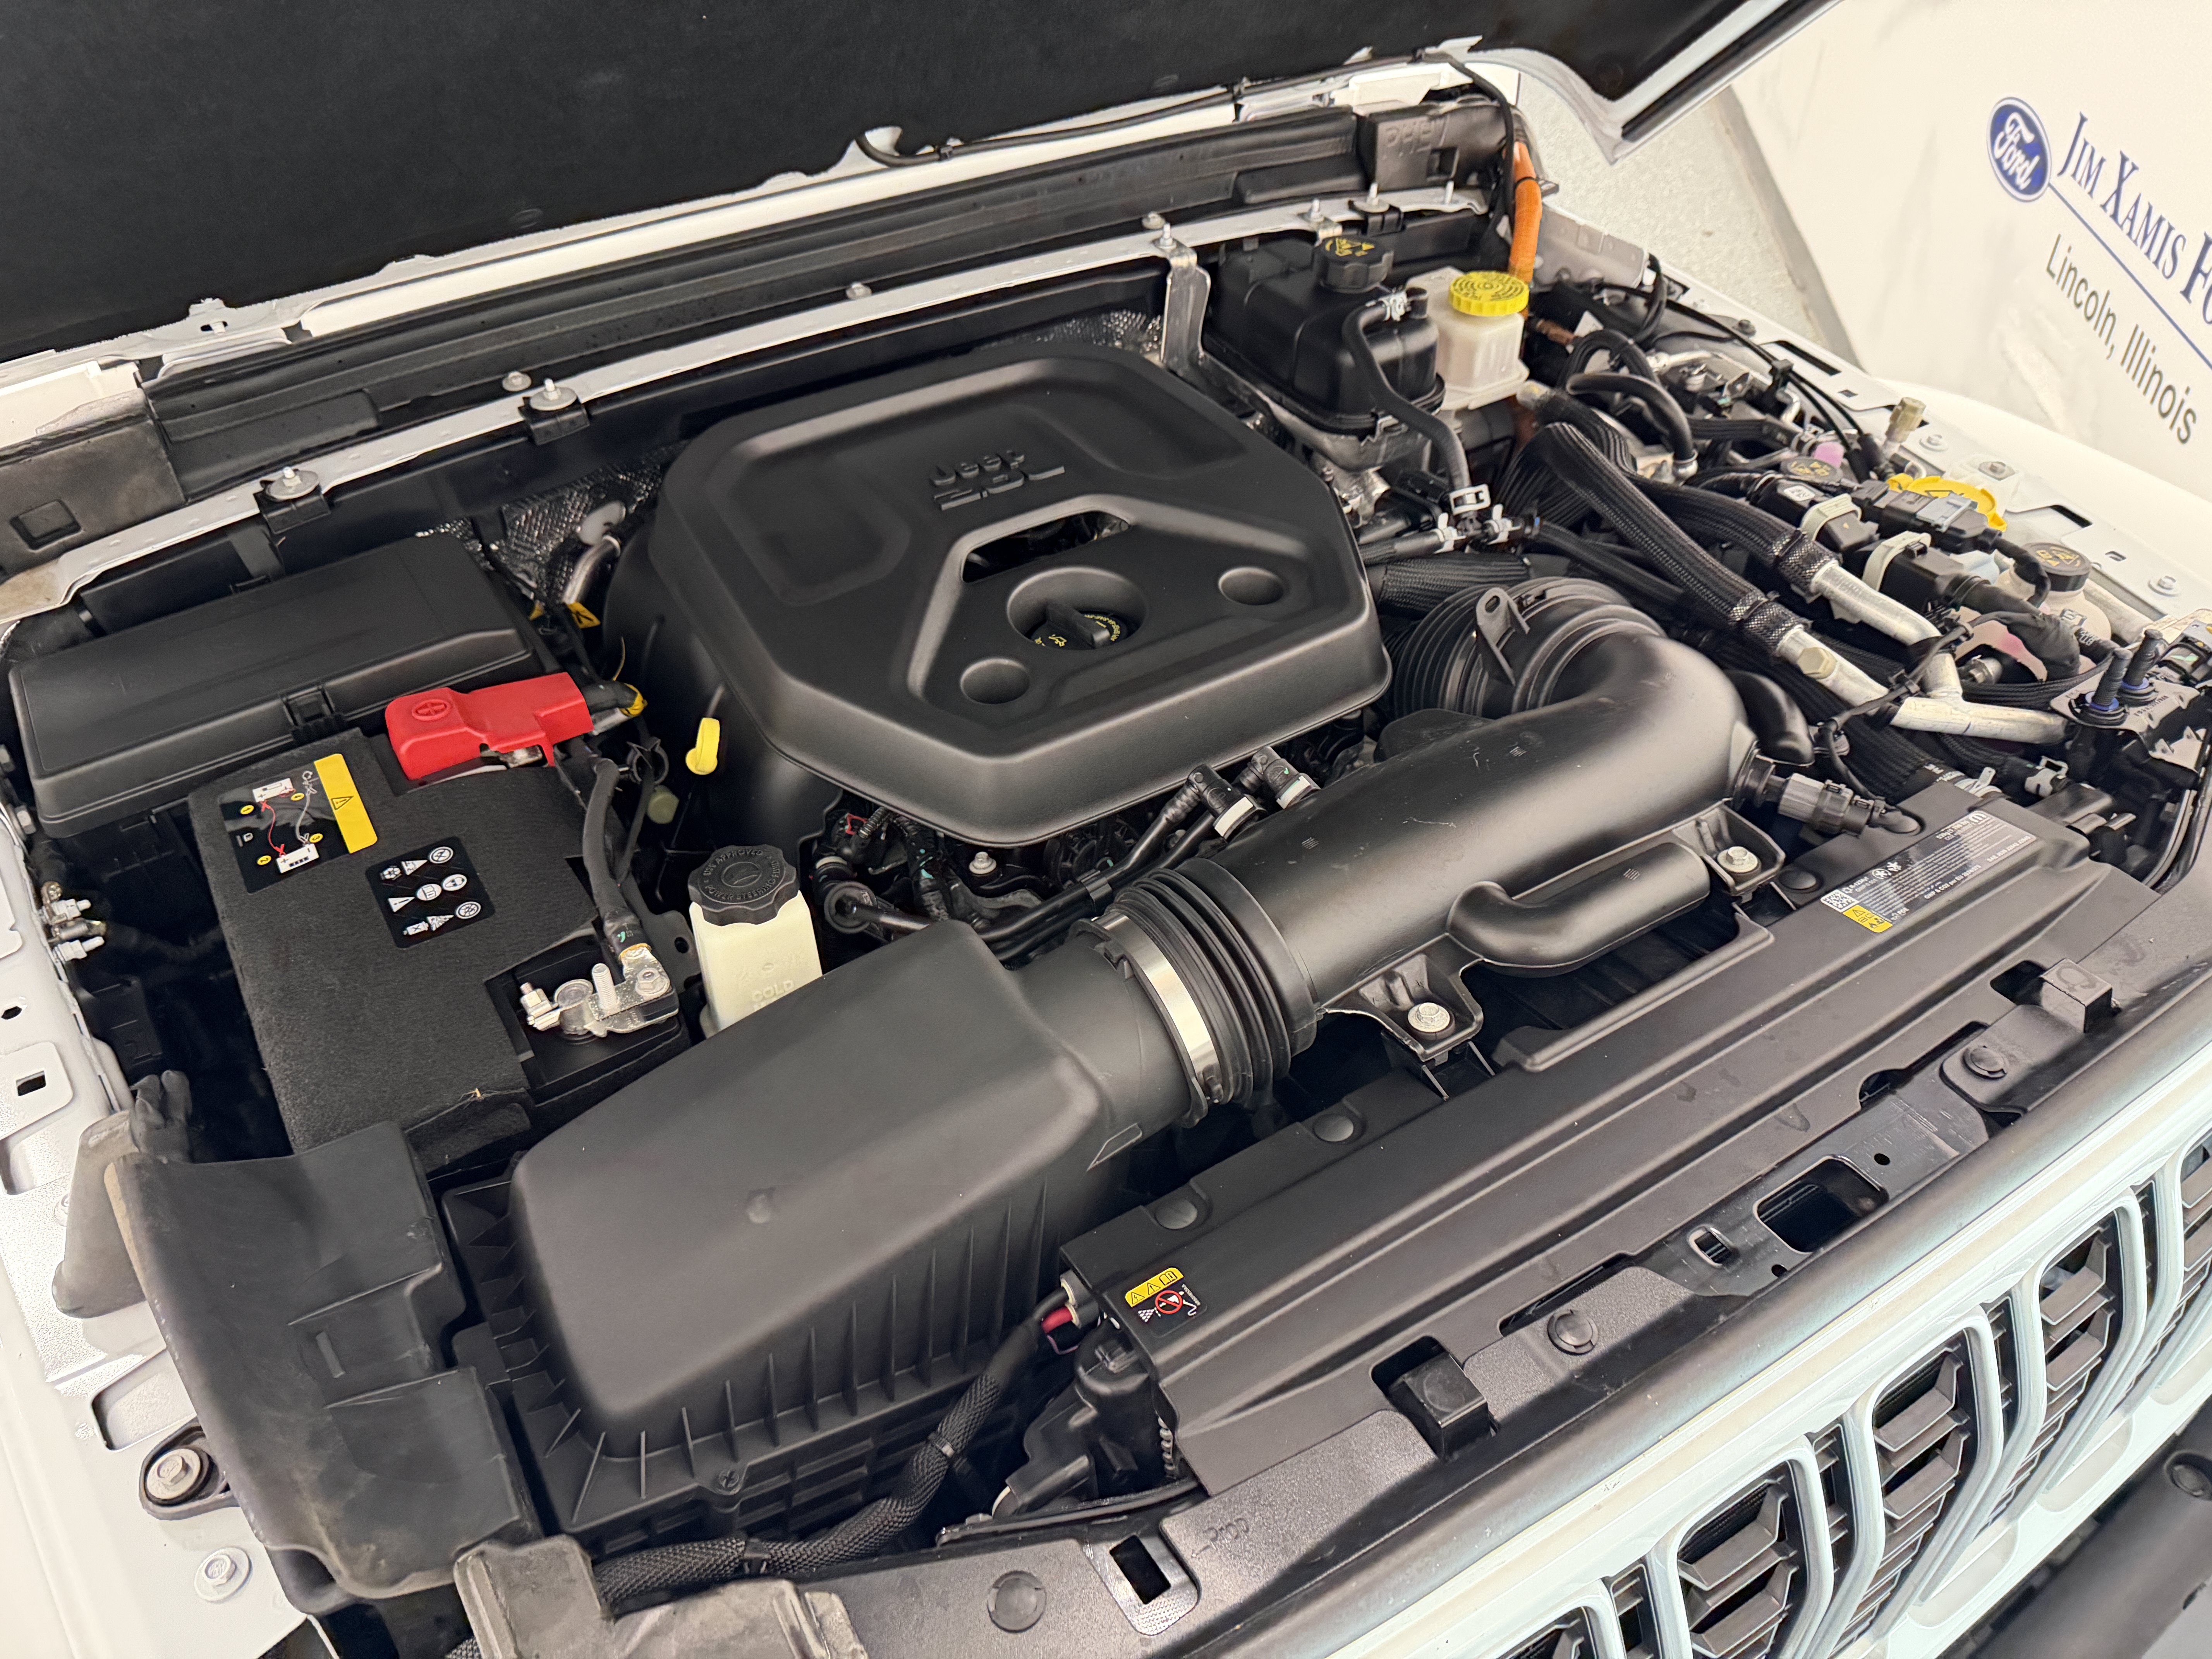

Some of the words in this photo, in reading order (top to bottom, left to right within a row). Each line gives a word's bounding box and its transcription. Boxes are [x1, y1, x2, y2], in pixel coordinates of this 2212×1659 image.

[1994, 112, 2040, 190] Ford
[2056, 110, 2107, 199] JIM
[2100, 150, 2187, 280] XAMIS
[2046, 233, 2117, 360] Lincoln,
[2121, 324, 2197, 445] Illinois
[715, 849, 763, 864] APPROVED
[705, 884, 734, 900] POWER
[736, 878, 776, 900] STEERING
[751, 980, 794, 1002] COLD
